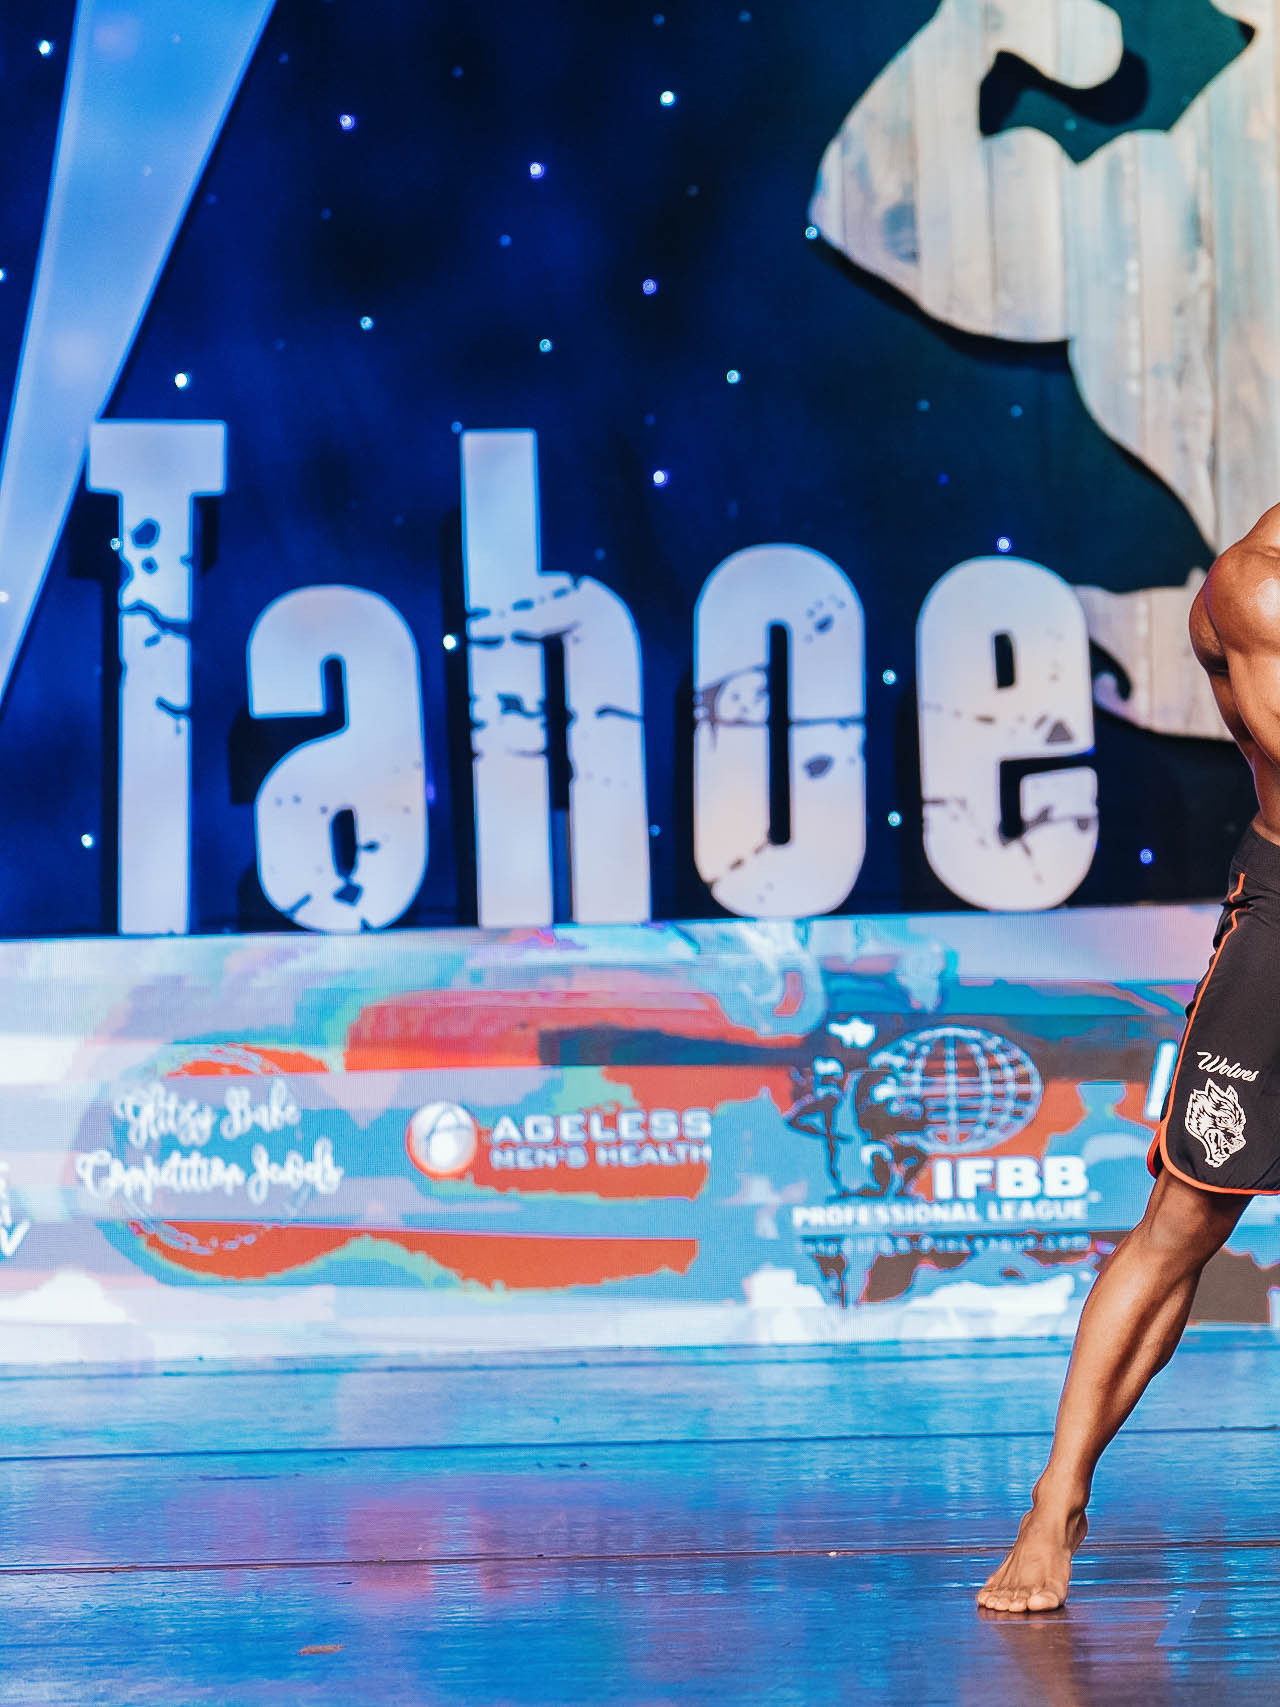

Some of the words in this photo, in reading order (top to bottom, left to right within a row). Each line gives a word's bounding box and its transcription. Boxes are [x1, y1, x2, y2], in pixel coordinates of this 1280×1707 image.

[86, 418, 1098, 936] Tahoe
[1196, 1050, 1260, 1082] Wolves
[490, 1108, 713, 1143] AGELESS
[490, 1146, 588, 1169] MEN'S
[596, 1143, 713, 1167] HEALTH
[933, 1155, 1090, 1200] IFBB
[792, 1202, 981, 1227] PROFESSIONAL
[985, 1198, 1090, 1223] LEAGUE
